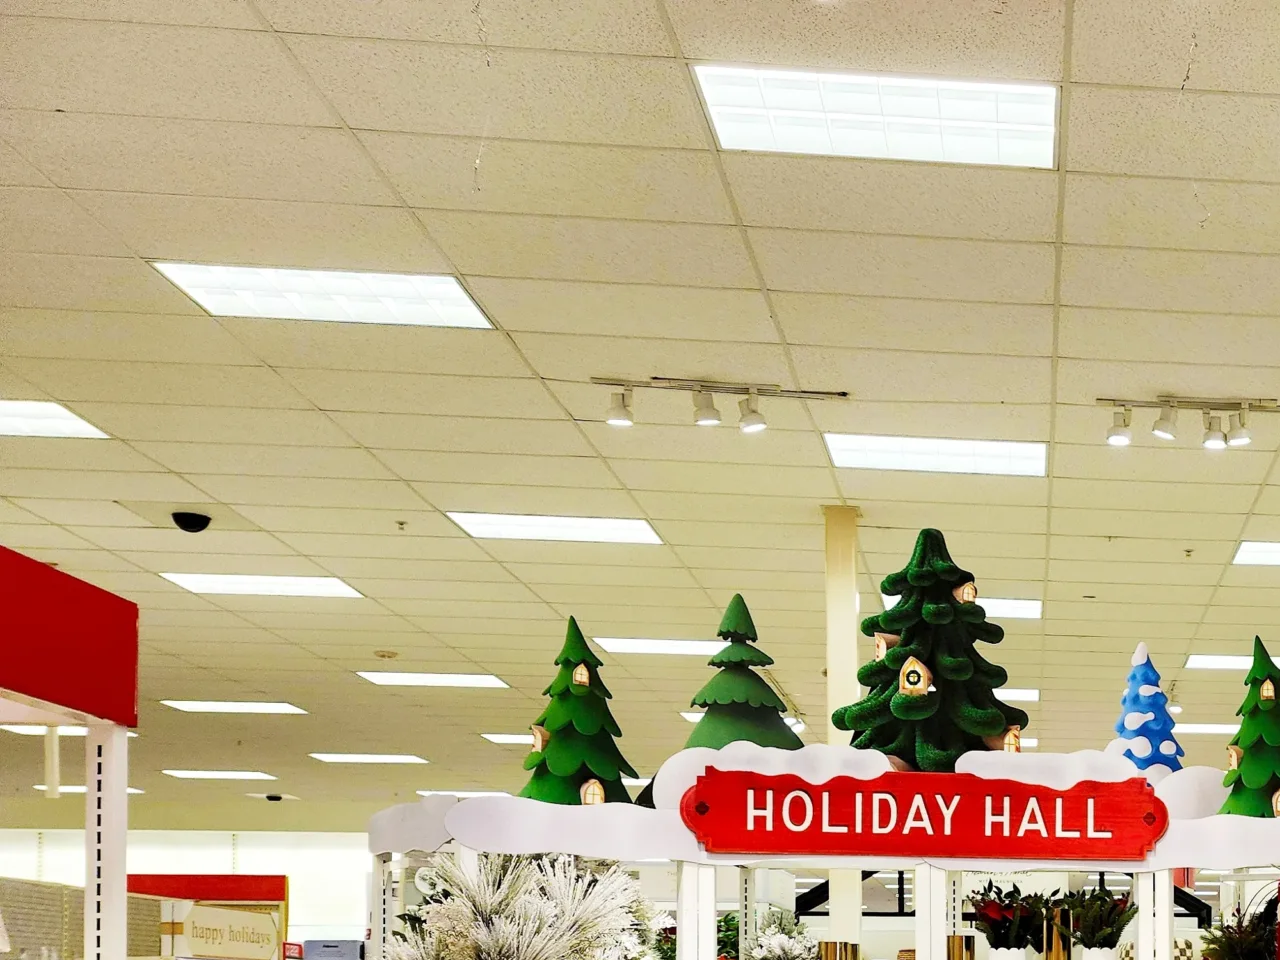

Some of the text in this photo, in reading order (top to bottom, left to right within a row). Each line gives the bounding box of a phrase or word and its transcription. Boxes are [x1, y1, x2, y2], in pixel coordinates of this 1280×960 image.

[746, 789, 1112, 838] HOLIDAY HALL
[192, 920, 271, 948] happy holidays
